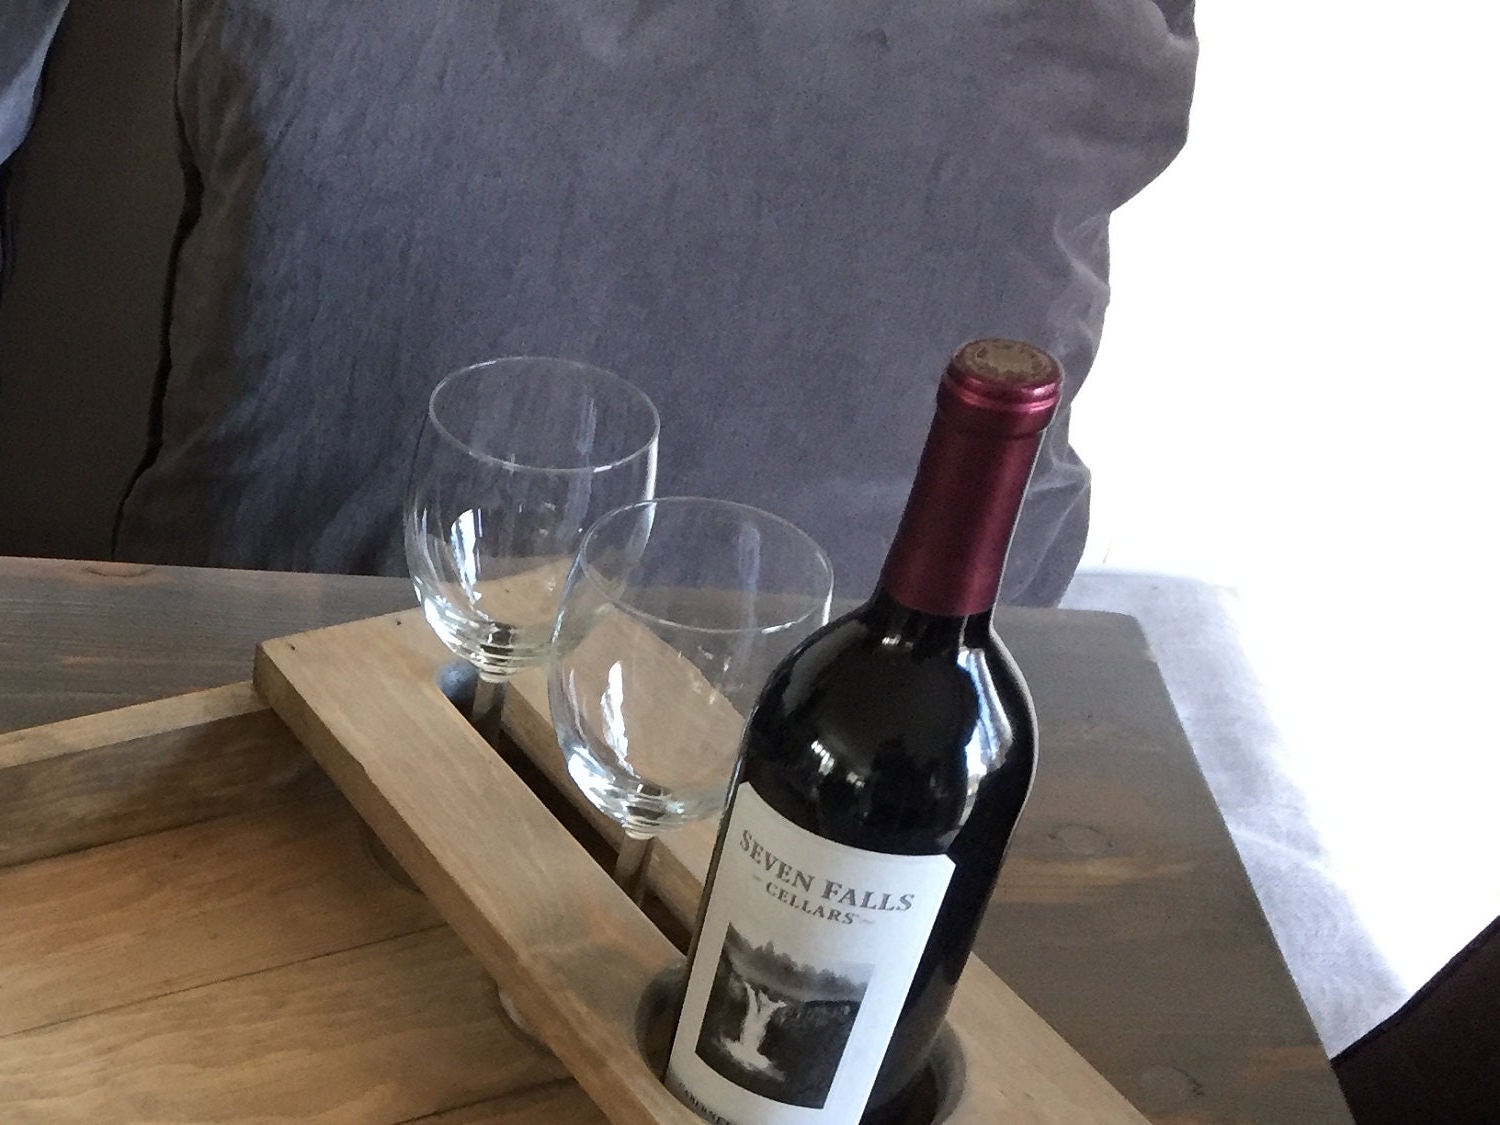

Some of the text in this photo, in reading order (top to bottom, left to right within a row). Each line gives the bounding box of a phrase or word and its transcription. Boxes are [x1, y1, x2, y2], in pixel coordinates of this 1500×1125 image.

[739, 829, 916, 912] SEVEN FALLS
[765, 882, 855, 925] CELLARS
